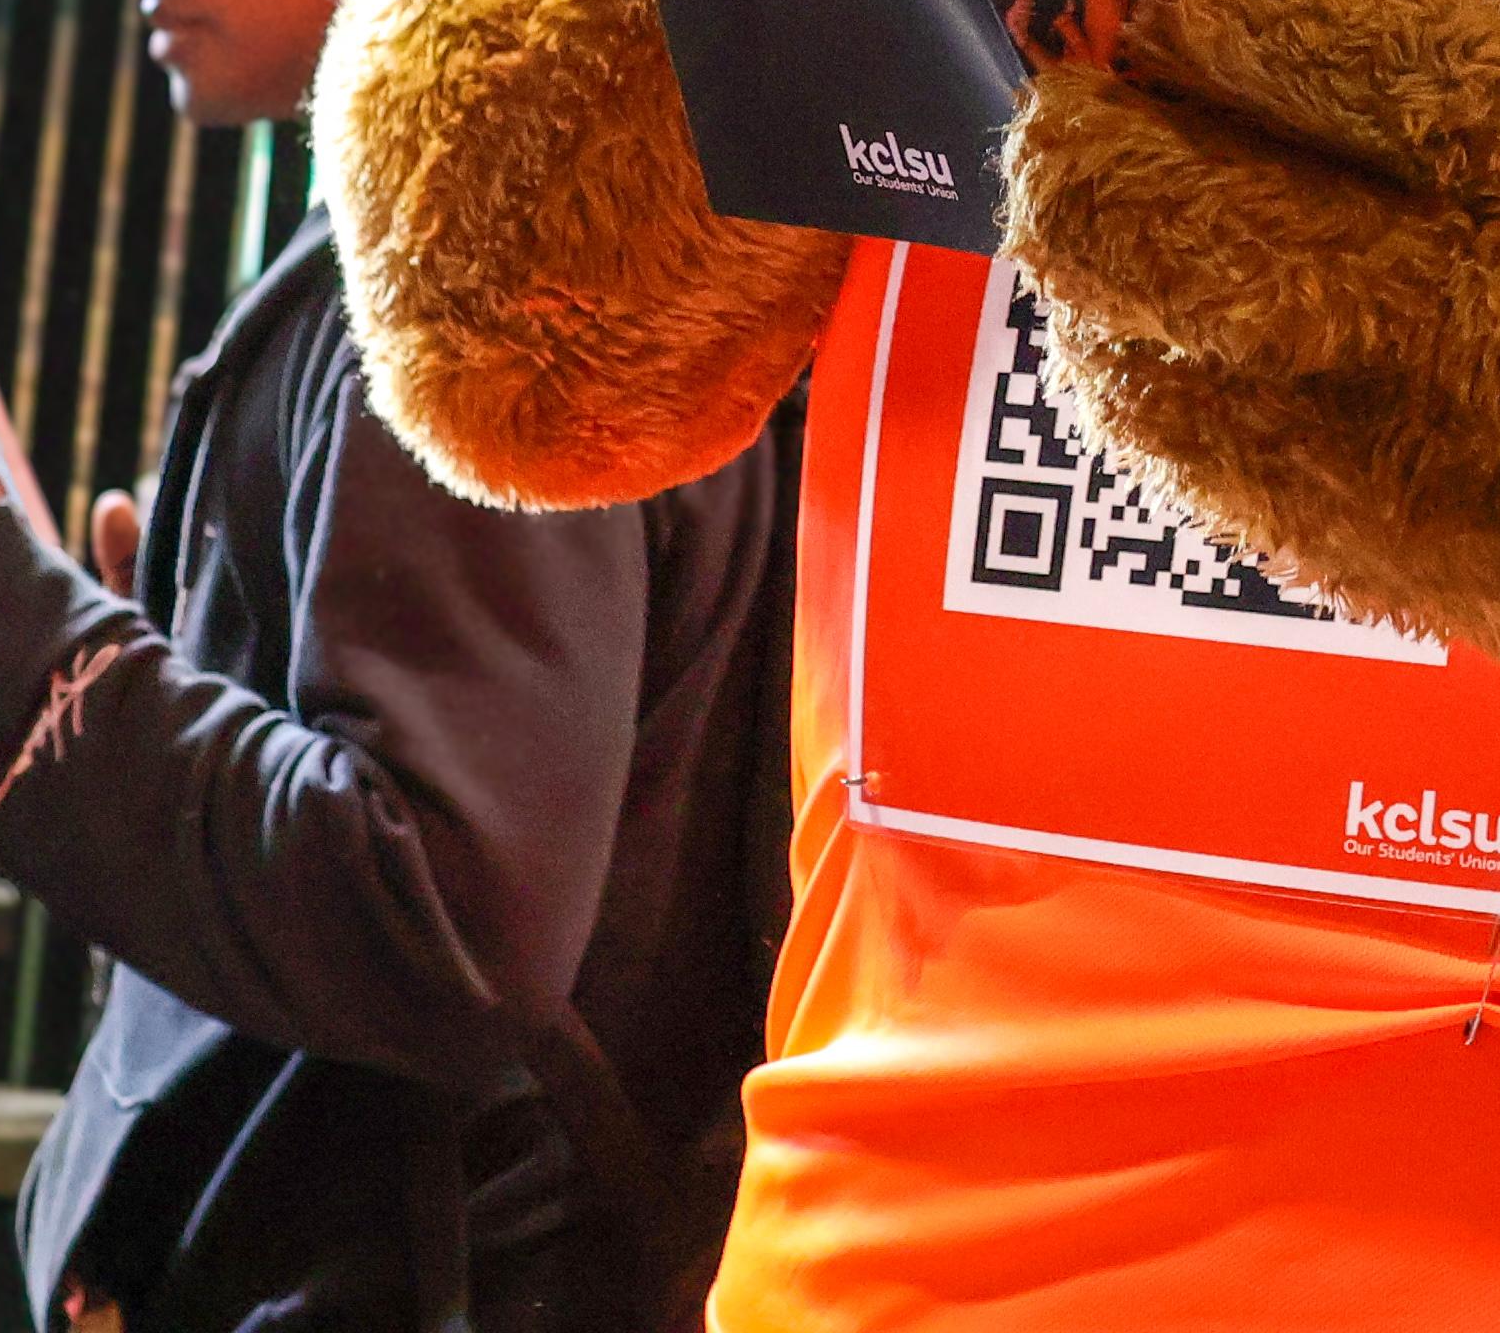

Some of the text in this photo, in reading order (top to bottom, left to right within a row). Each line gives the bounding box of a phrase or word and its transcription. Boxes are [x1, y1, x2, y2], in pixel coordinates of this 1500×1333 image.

[839, 123, 955, 187] kclsu
[853, 172, 873, 185] Our
[927, 183, 959, 201] Union
[1343, 839, 1375, 856] Our
[1378, 843, 1454, 866] Students'
